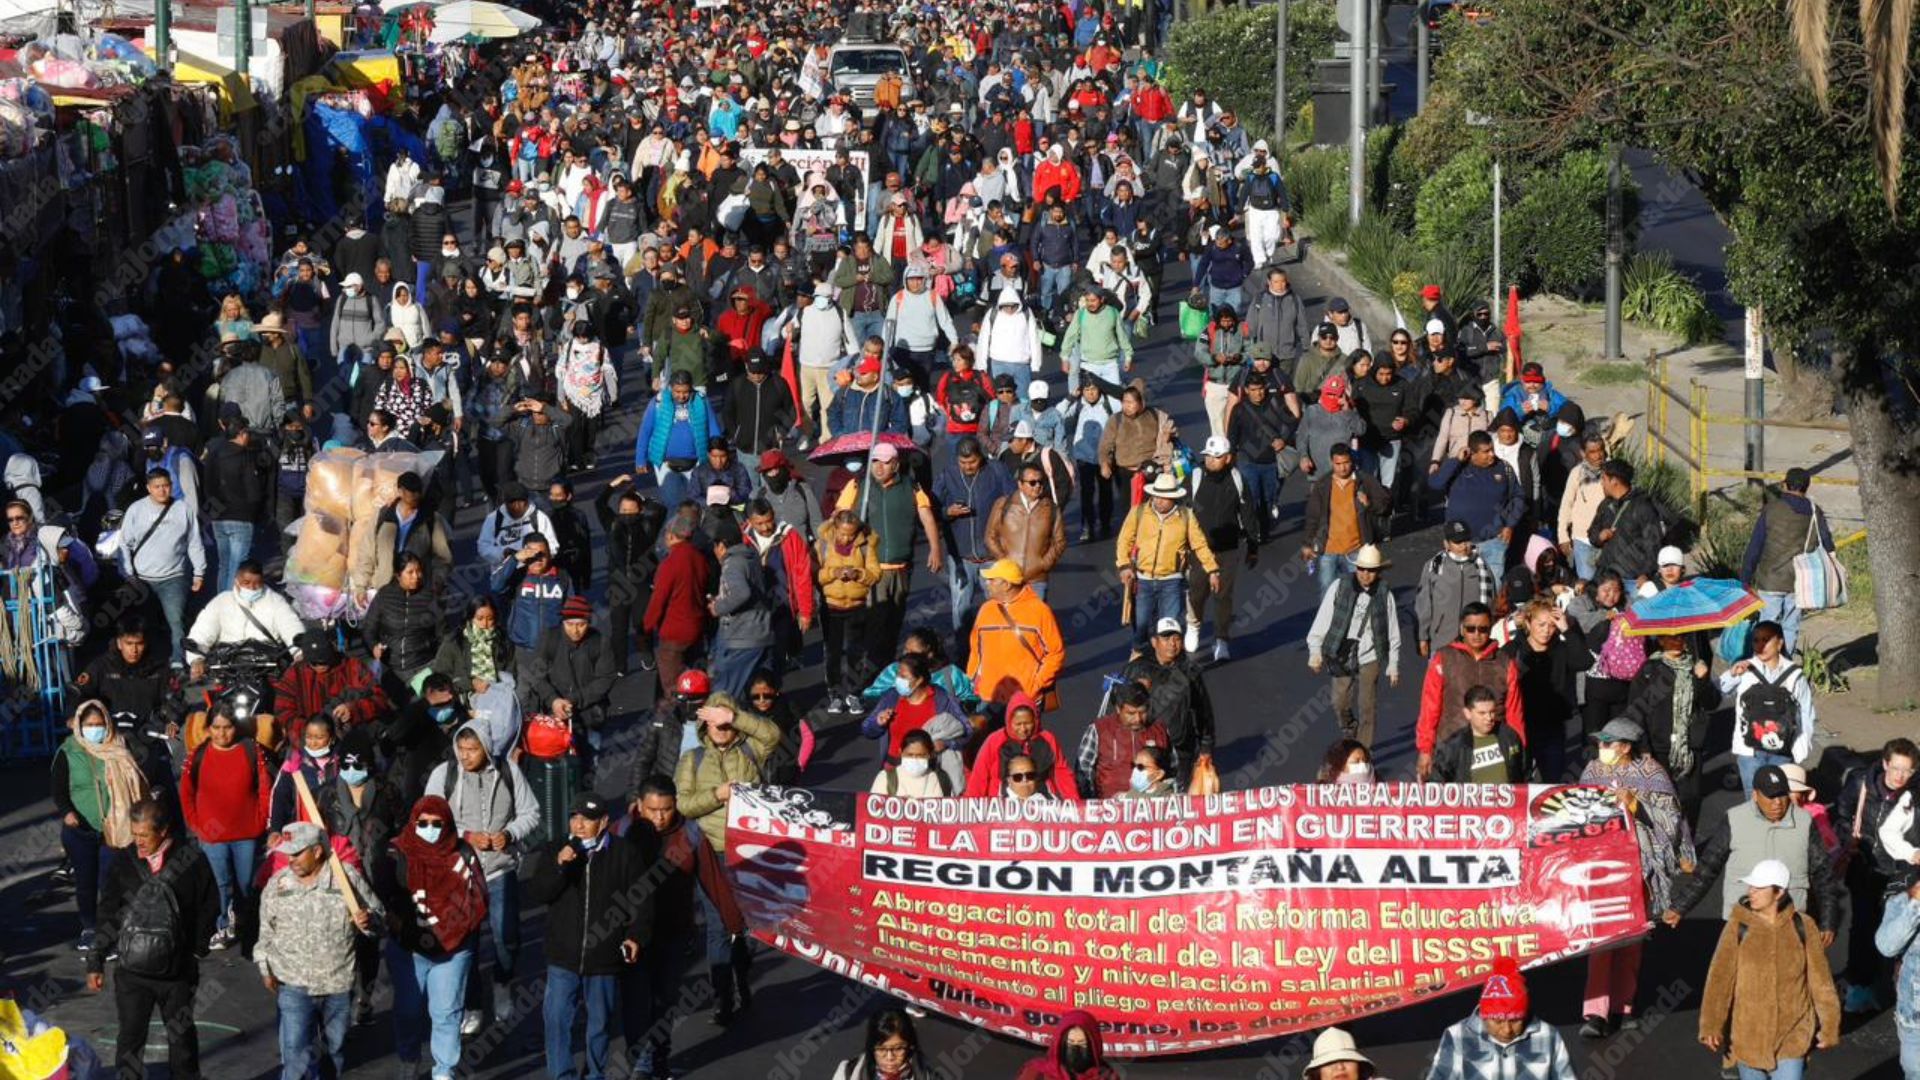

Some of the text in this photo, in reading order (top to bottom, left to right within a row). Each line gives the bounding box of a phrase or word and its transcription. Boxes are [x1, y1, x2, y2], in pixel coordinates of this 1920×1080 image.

[521, 583, 563, 599] FILA
[866, 781, 1516, 824] COORDINADORA ESTATAL DE LOS TRABAJADORES
[864, 813, 1515, 854] DE LA EDUCACIÓN EN GUERRERO
[864, 848, 1514, 893] REGIÓN MONTAÑA ALTA
[872, 889, 1538, 934] Abrogación total de la Reforma Educativa
[876, 912, 1075, 957] Abrogación
[1084, 937, 1167, 965] total
[1176, 940, 1222, 968] de
[1231, 939, 1263, 968] la
[1273, 938, 1338, 979] Ley
[1346, 937, 1402, 966] del
[1411, 932, 1540, 965] ISSSTE
[879, 928, 1065, 979] Incremento
[1073, 964, 1095, 986] y
[1102, 964, 1271, 994] nivelación
[1280, 969, 1404, 994] salarial
[1043, 986, 1068, 1003] al
[1073, 988, 1149, 1014] pliego
[1156, 997, 1263, 1014] petitorio
[1269, 996, 1300, 1011] de
